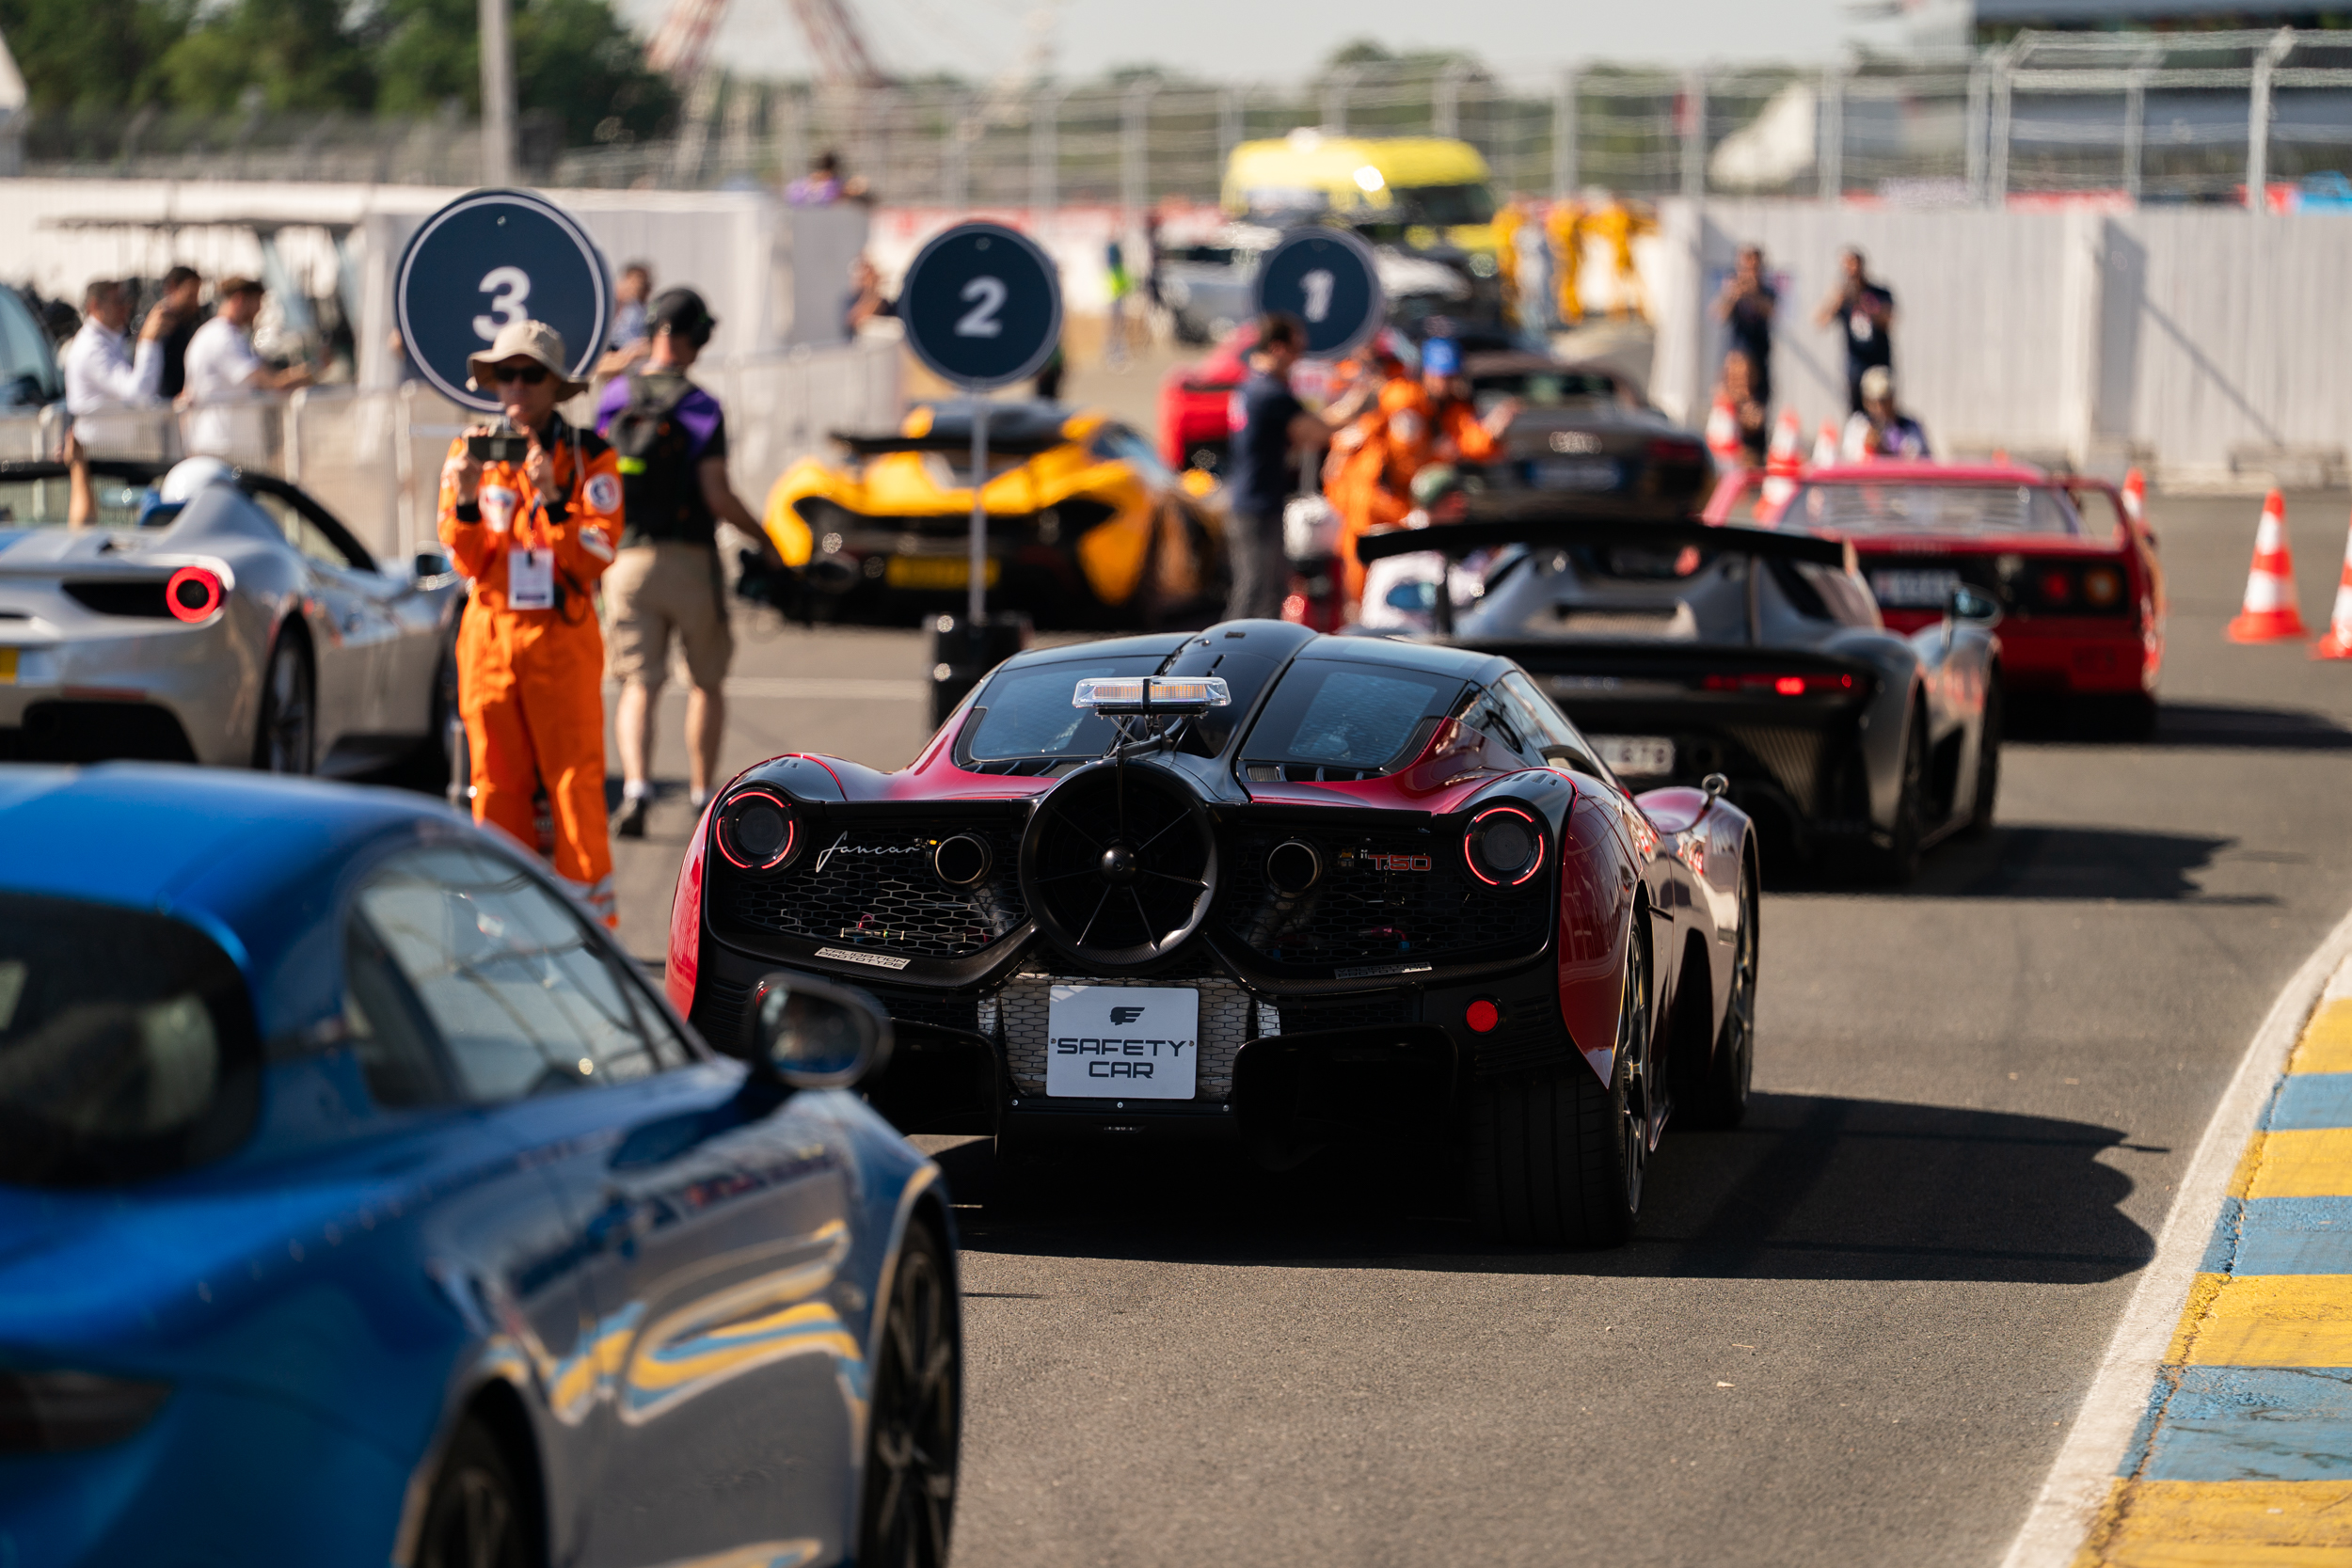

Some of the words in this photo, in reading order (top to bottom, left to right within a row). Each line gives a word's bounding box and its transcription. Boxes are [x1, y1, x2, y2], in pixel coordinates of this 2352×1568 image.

[472, 265, 532, 342] 3
[1299, 268, 1335, 323] 1
[954, 275, 1008, 338] 2
[816, 831, 920, 873] fancar
[1368, 854, 1432, 871] T.50
[818, 951, 904, 969] PROTOTYPE
[823, 947, 908, 964] VALIDATION
[1338, 962, 1428, 973] VALIDATION
[1057, 1037, 1187, 1057] SAFETY
[1089, 1061, 1154, 1079] CAR
